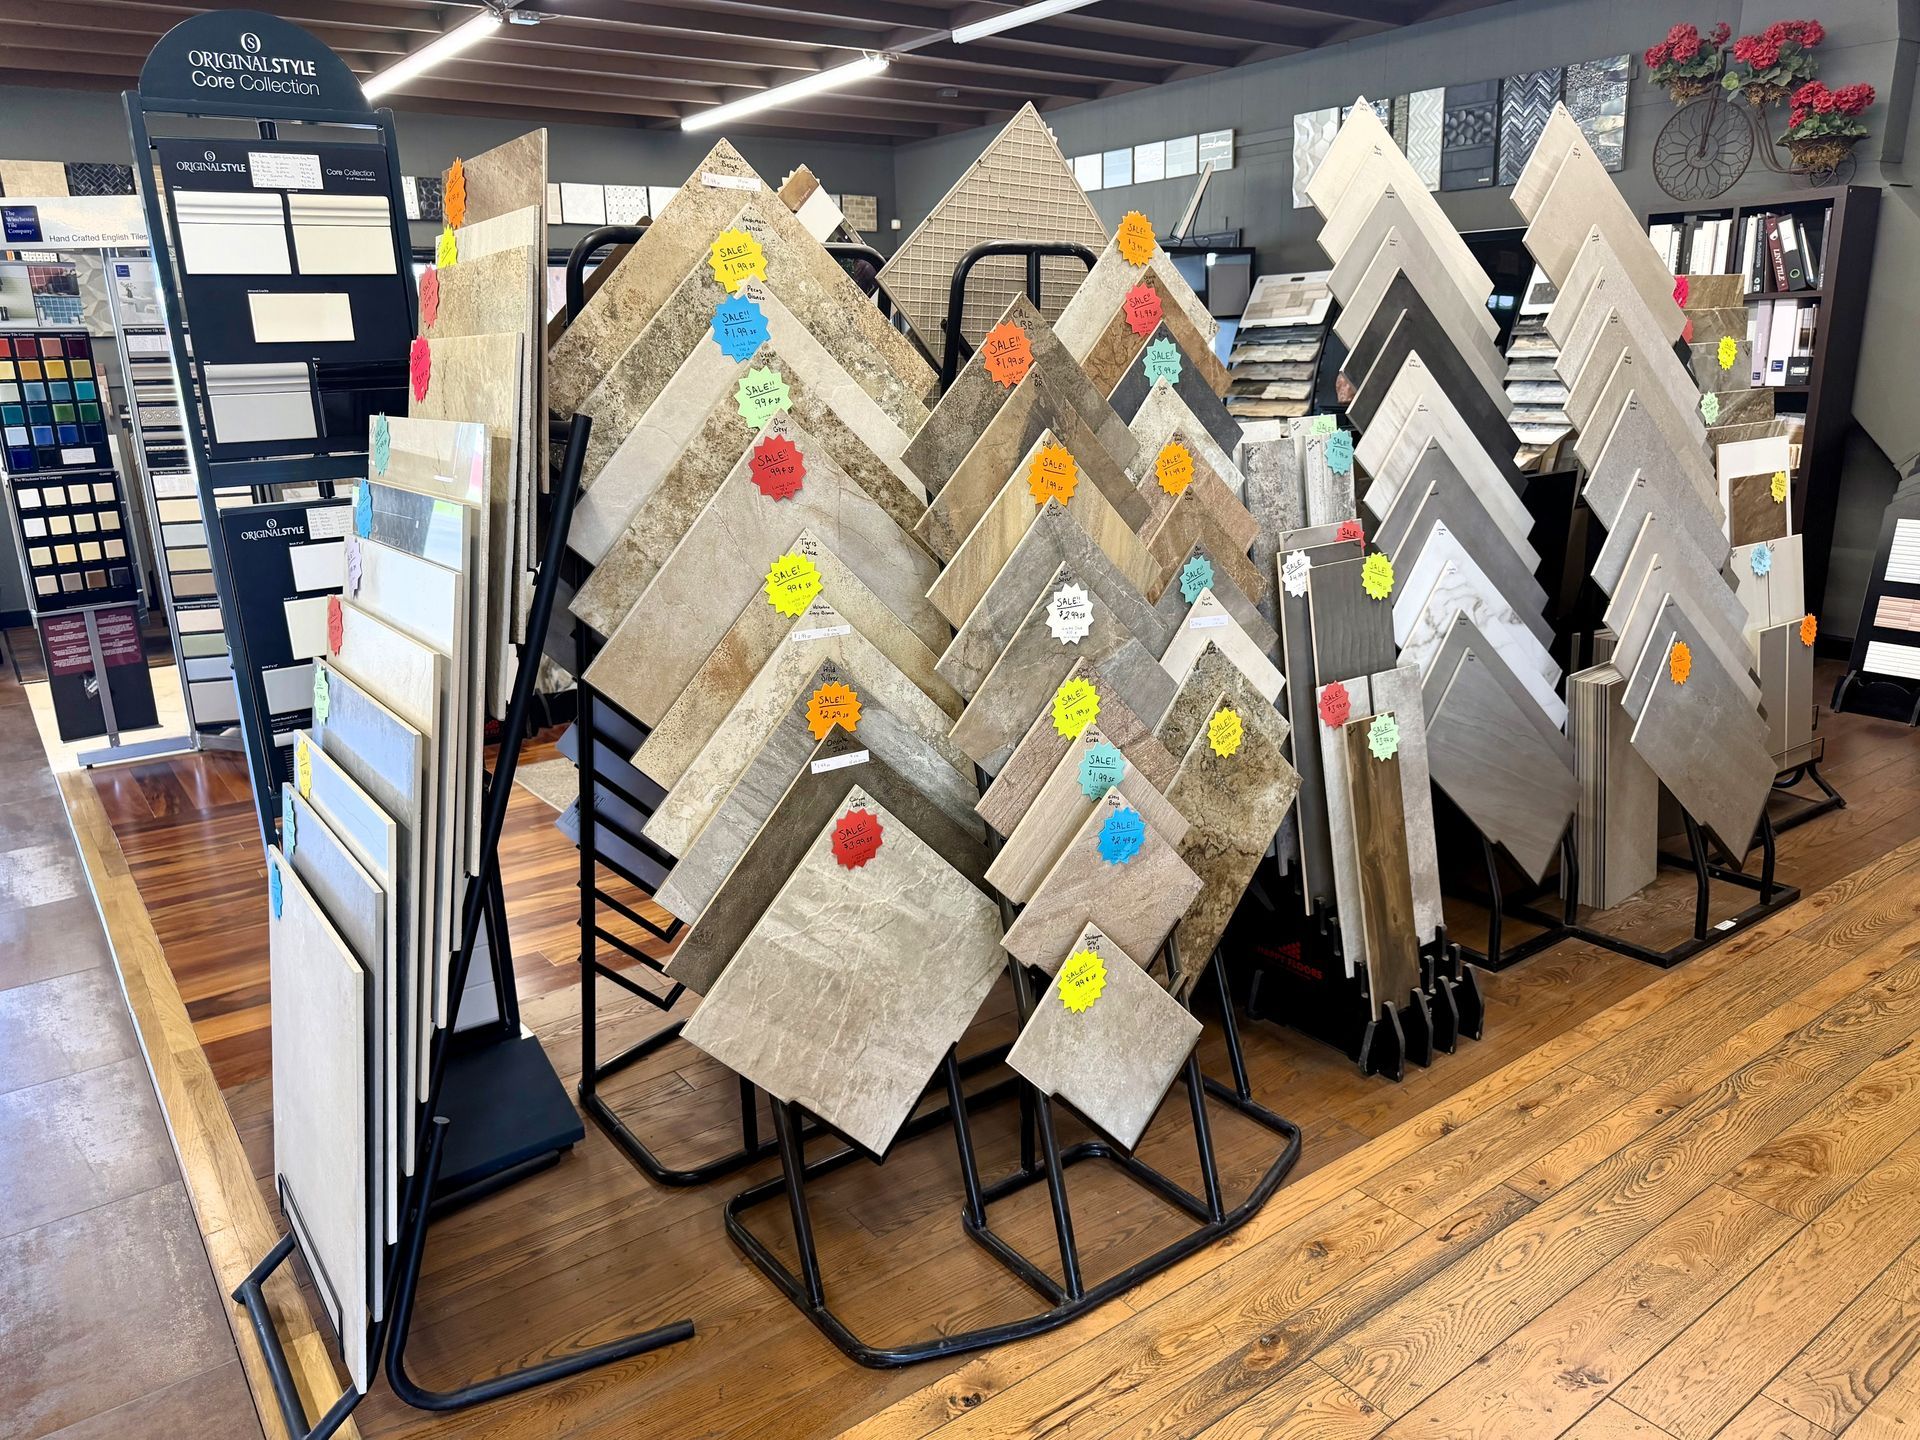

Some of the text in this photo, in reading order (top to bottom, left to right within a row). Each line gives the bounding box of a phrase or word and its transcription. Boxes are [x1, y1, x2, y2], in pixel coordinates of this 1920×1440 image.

[191, 70, 320, 96] Core Collection
[326, 168, 376, 178] Core Collection
[71, 234, 100, 242] Crafted
[101, 234, 129, 243] English
[131, 233, 148, 241] Tiles
[719, 243, 748, 258] SALE!!
[722, 310, 750, 324] SALE!!
[724, 327, 748, 338] $1.99
[989, 336, 1022, 355] SALE!!
[996, 357, 1018, 369] $1.99
[745, 381, 775, 396] SALE!!
[757, 449, 789, 467] SALE!!
[818, 695, 845, 705] SALE!!
[1088, 754, 1117, 766] SALE!!
[1087, 769, 1108, 783] $1.99
[838, 819, 867, 841] SALE!!
[1109, 820, 1136, 831] SALE!!
